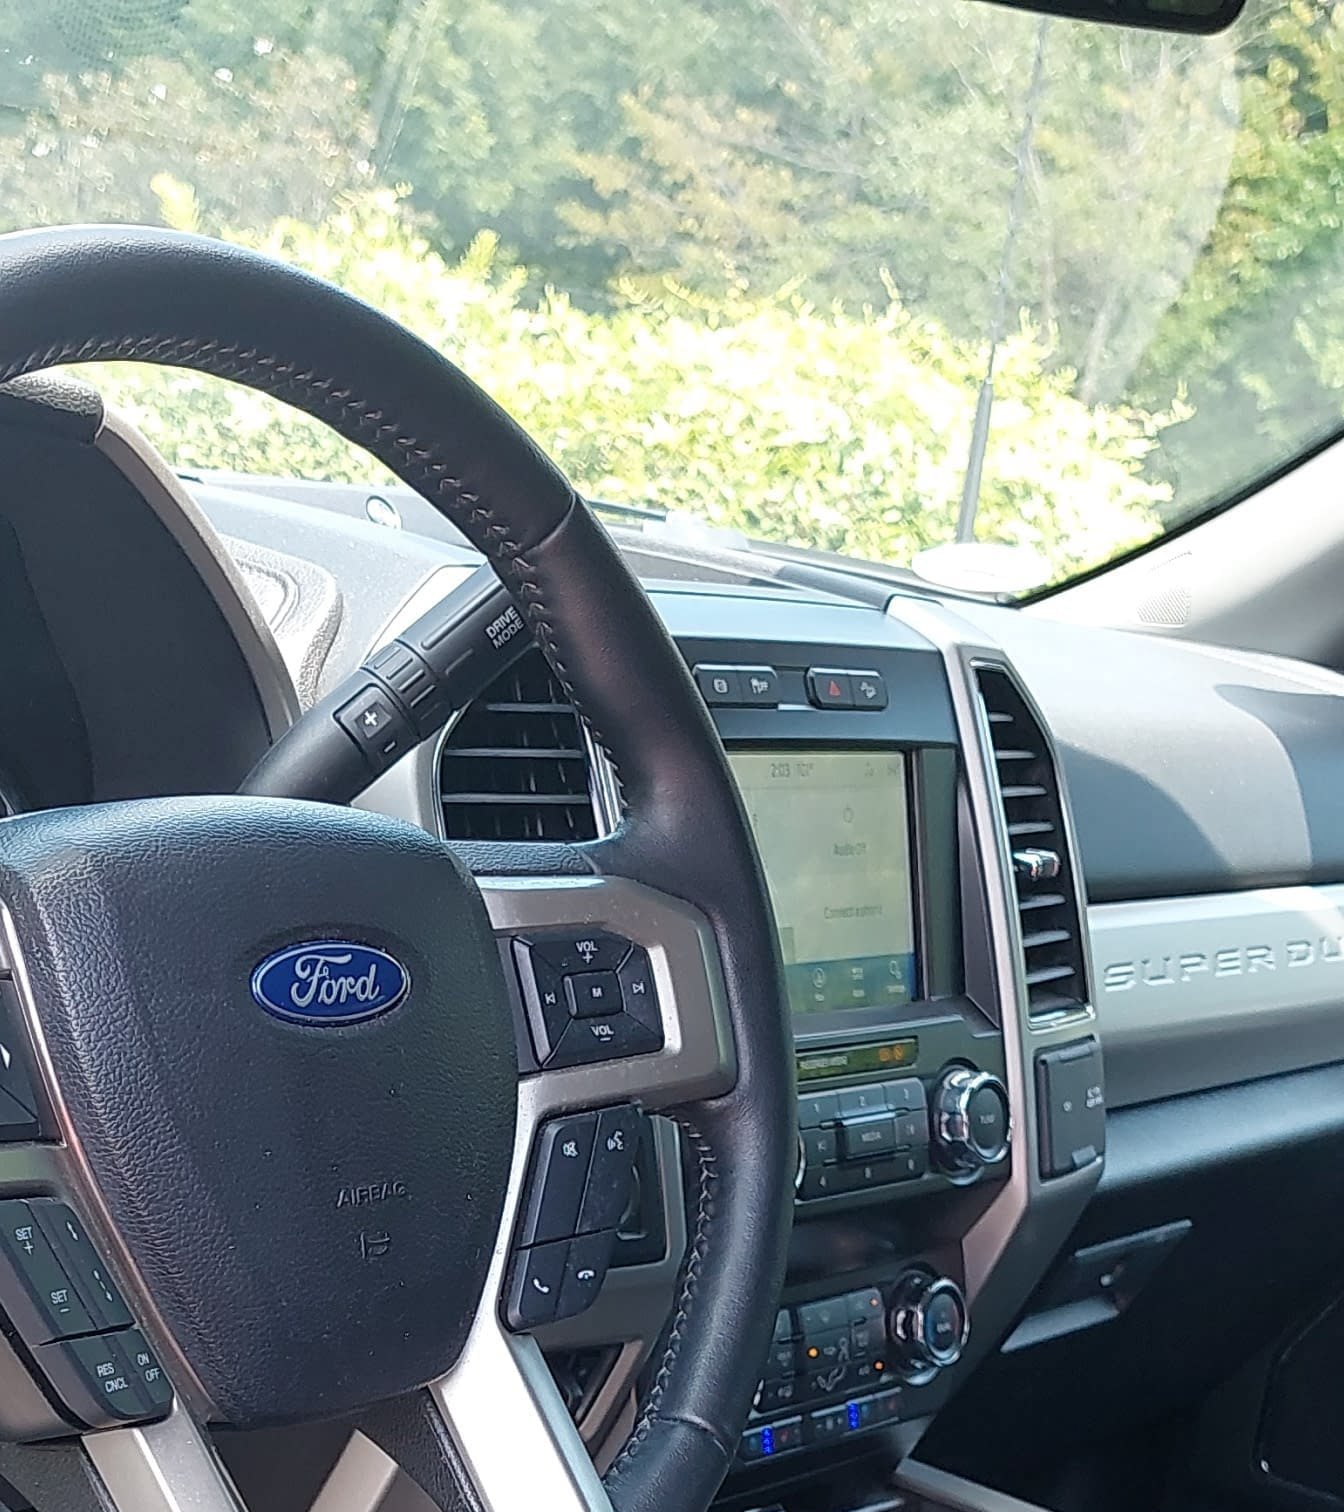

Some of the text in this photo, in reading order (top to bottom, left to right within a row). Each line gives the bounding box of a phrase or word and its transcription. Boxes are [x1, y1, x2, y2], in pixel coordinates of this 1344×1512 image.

[485, 605, 518, 639] DRIVE
[492, 617, 524, 649] MODE
[576, 940, 598, 953] VOL
[1103, 943, 1277, 993] SUPER
[290, 952, 381, 1008] Ford
[591, 1024, 614, 1037] VOL
[337, 1181, 406, 1208] AIRBAG
[15, 1226, 33, 1241] SET
[51, 1290, 68, 1305] SET
[137, 1353, 150, 1366] ON
[96, 1363, 115, 1378] RES
[145, 1368, 161, 1382] OFF
[105, 1378, 129, 1393] CNCL
